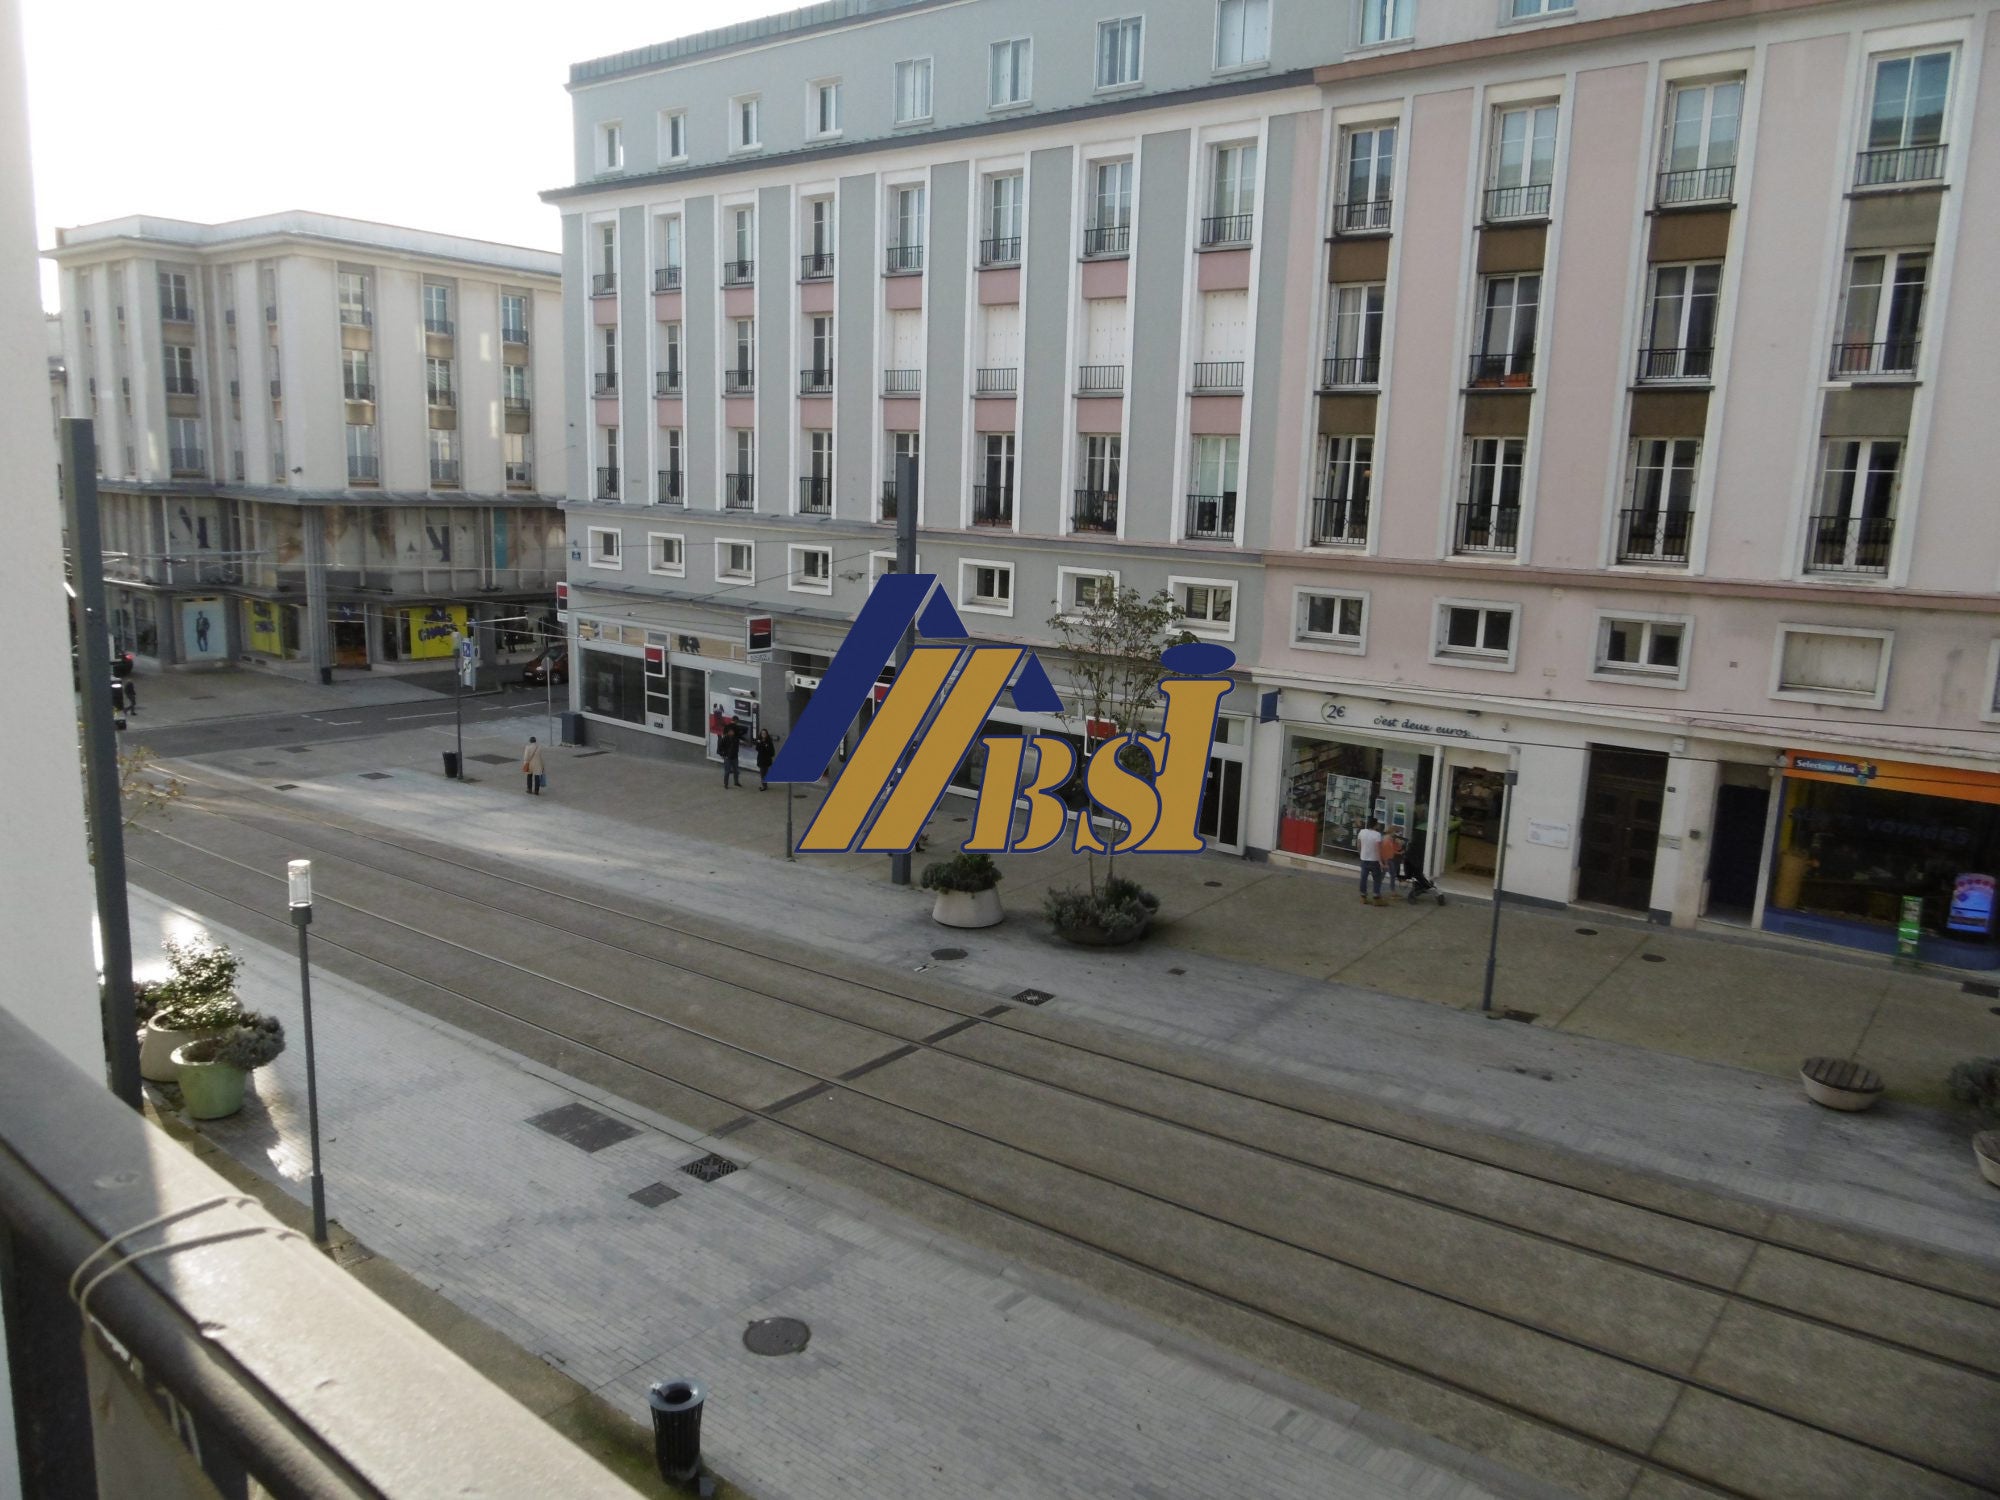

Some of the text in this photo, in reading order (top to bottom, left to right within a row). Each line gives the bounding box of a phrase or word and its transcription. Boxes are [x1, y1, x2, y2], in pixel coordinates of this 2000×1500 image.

[1326, 704, 1346, 719] 2€
[1373, 715, 1399, 728] c'est
[1401, 718, 1434, 732] deux
